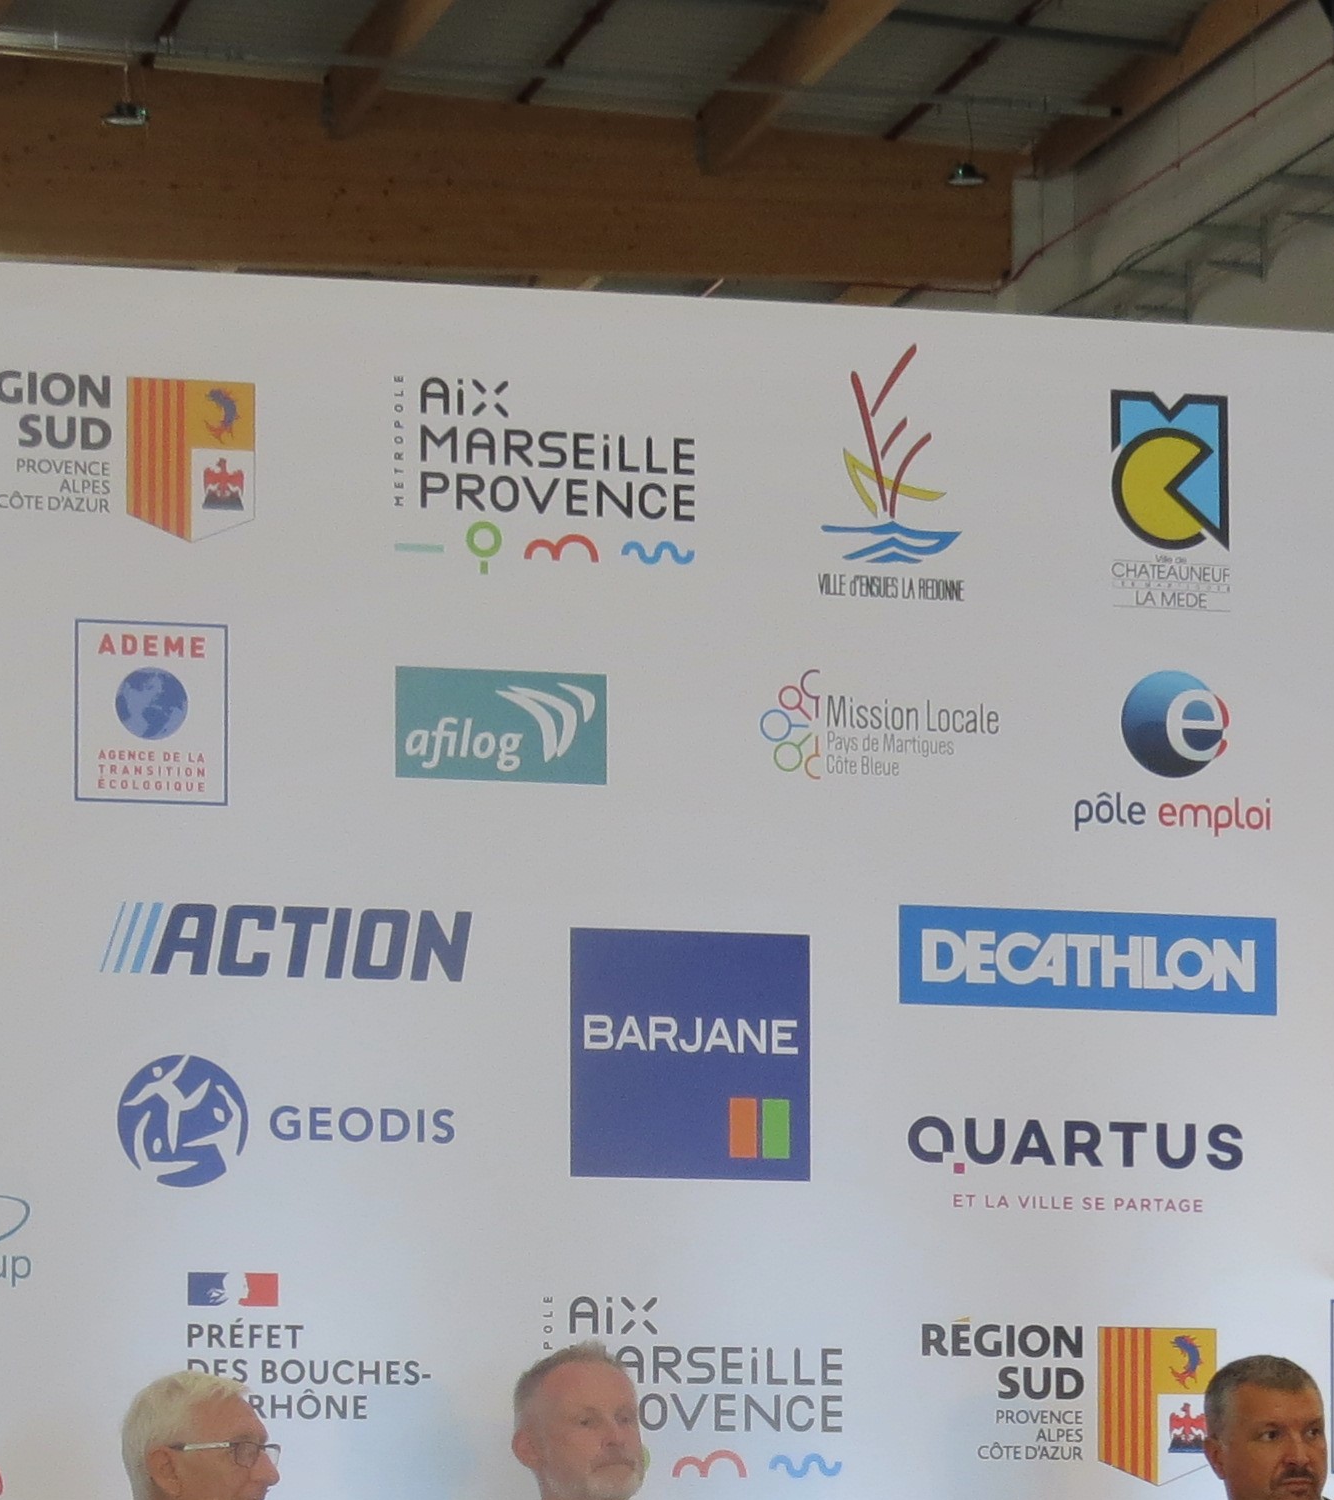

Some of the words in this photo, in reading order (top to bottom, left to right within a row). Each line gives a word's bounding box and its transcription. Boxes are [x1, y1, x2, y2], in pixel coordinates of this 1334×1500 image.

[17, 415, 112, 451] SUD
[16, 458, 110, 477] PROVENCE
[59, 477, 110, 495] ALPES
[420, 471, 695, 522] PROVENCE
[47, 495, 110, 514] D'AZUR
[1111, 562, 1230, 583] CHATEAUNEUF
[818, 573, 846, 596] VILLE
[902, 576, 915, 598] LA
[919, 577, 965, 601] REDONNE
[1136, 590, 1156, 606] LA
[1161, 591, 1208, 608] MEDE
[98, 633, 206, 659] ADEME
[826, 695, 919, 731] Mission
[926, 701, 999, 736] Locale
[98, 750, 156, 762] AGENCE
[163, 751, 180, 763] DE
[187, 751, 205, 763] LA
[405, 717, 524, 772] afilog
[826, 733, 858, 754] Pays
[862, 734, 878, 753] de
[883, 734, 955, 759] Martigues
[98, 764, 206, 778] TRANSITION
[826, 754, 856, 775] Côte
[860, 757, 900, 776] Bleue
[98, 776, 206, 793] ÉCOLOGIQUE
[1074, 792, 1146, 831] pôle
[1158, 797, 1271, 836] emploi
[150, 903, 472, 983] ACTION
[922, 929, 1256, 993] DECATHLON
[583, 1015, 799, 1055] BARJANE
[269, 1105, 456, 1145] GEODIS
[907, 1115, 1244, 1175] QUARTUS
[952, 1193, 978, 1209] ET
[984, 1194, 1010, 1210] LA
[1016, 1195, 1073, 1212] VILLE
[1081, 1196, 1106, 1212] SE
[1114, 1197, 1204, 1214] PARTAGE
[187, 1319, 304, 1349] PRÉFET
[921, 1316, 1084, 1358] RÉGION
[261, 1358, 431, 1386] BOUCHES-
[617, 1346, 843, 1386] ARSEiLLE
[997, 1366, 1085, 1400] SUD
[248, 1388, 367, 1420] RHÔNE
[639, 1393, 843, 1433] OVENCE
[995, 1409, 1084, 1426] PROVENCE
[1035, 1427, 1084, 1444] ALPES
[977, 1440, 1022, 1460] CÔTE
[1024, 1445, 1084, 1461] D'AZUR
